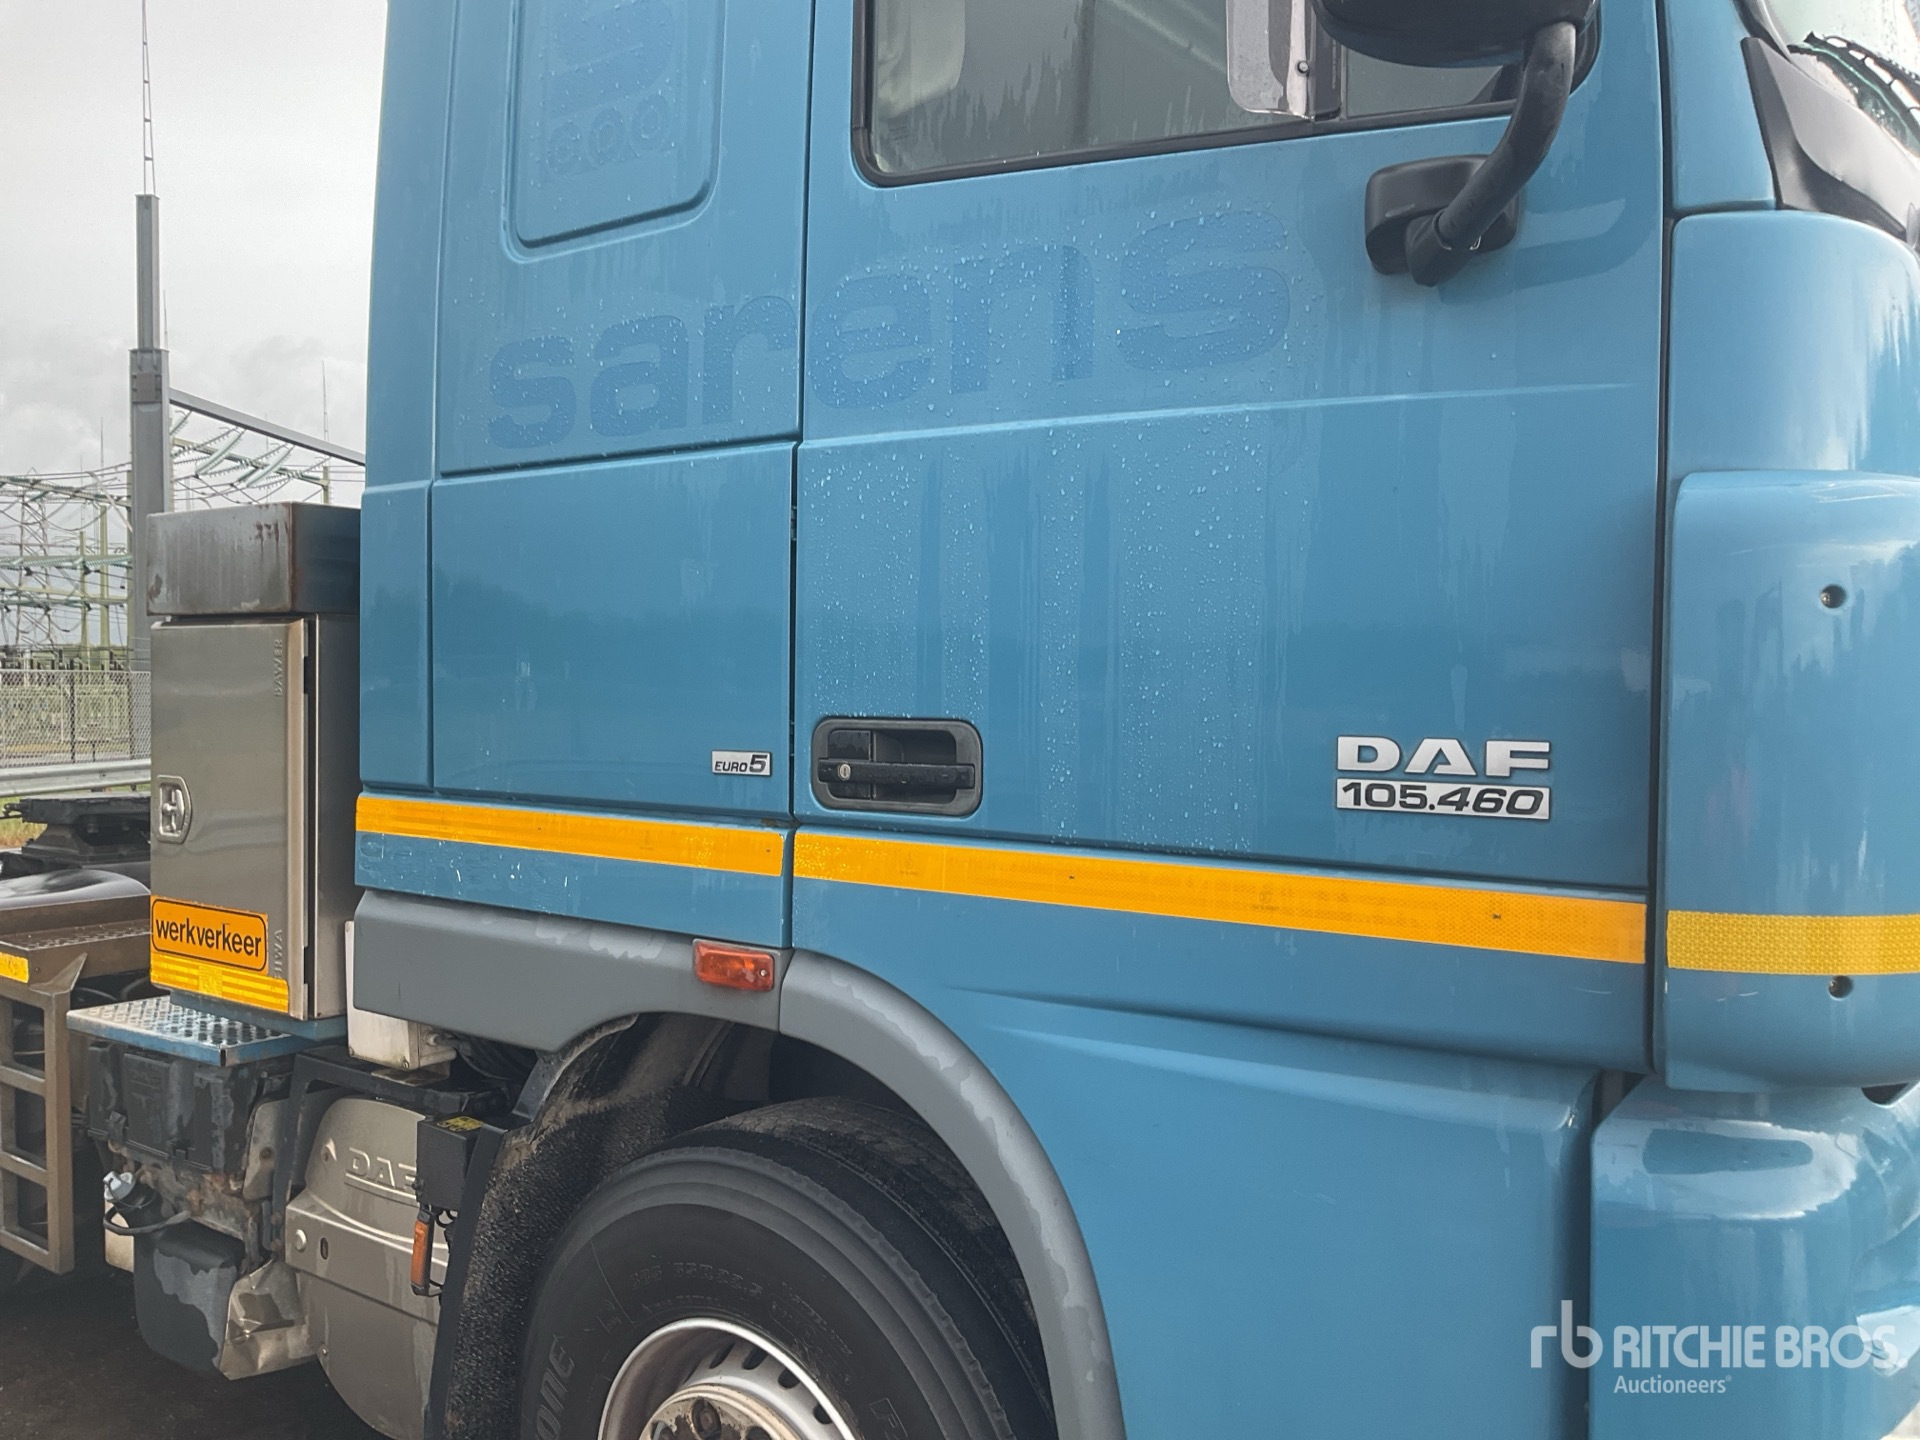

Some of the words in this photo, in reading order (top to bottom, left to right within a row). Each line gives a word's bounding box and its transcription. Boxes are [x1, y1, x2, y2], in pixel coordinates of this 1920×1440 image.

[488, 208, 1291, 450] sarens
[1337, 736, 1550, 776] DAF
[1342, 782, 1544, 815] 105.460
[155, 917, 262, 957] werkverkeer
